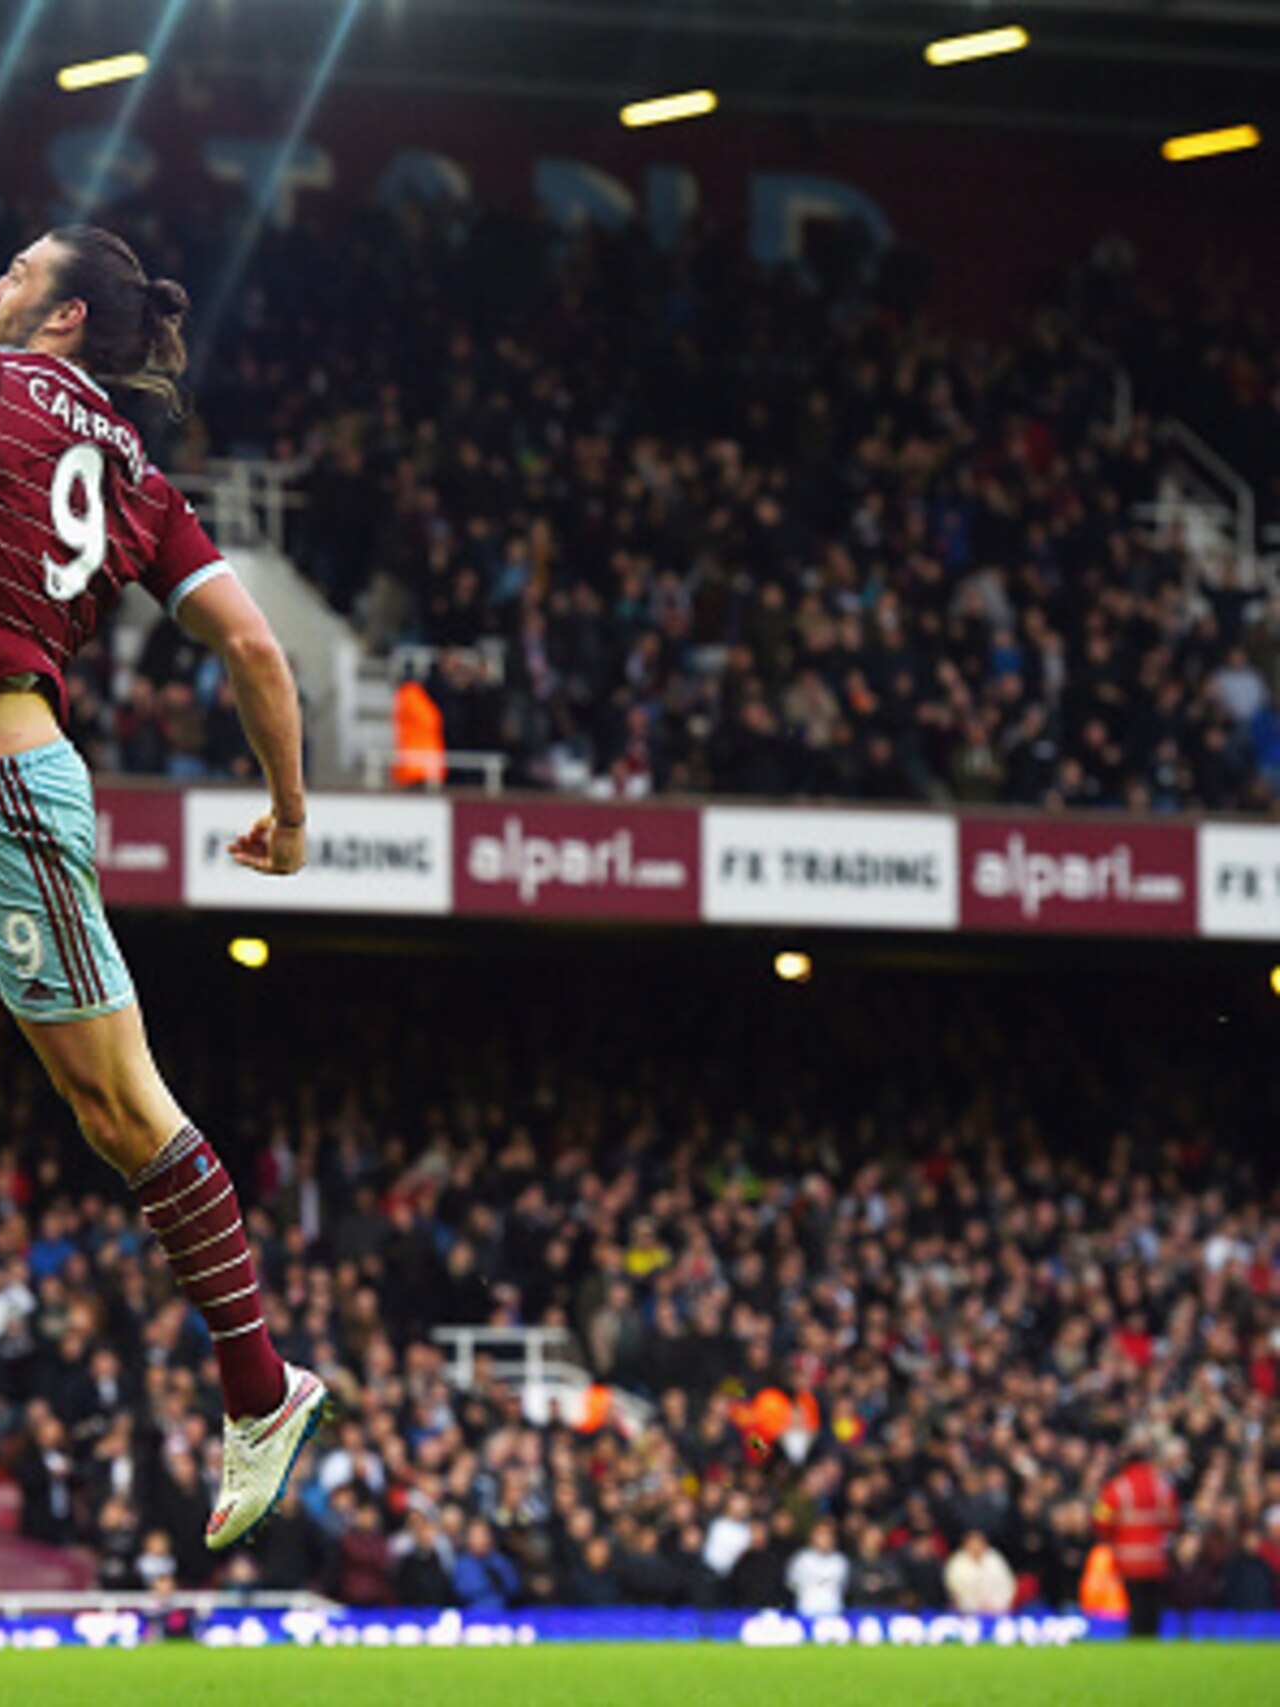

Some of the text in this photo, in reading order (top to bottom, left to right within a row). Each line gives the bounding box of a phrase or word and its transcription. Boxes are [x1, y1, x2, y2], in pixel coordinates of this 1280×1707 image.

[43, 441, 106, 600] 9
[721, 847, 940, 891] FX TRADING
[4, 911, 43, 979] 9
